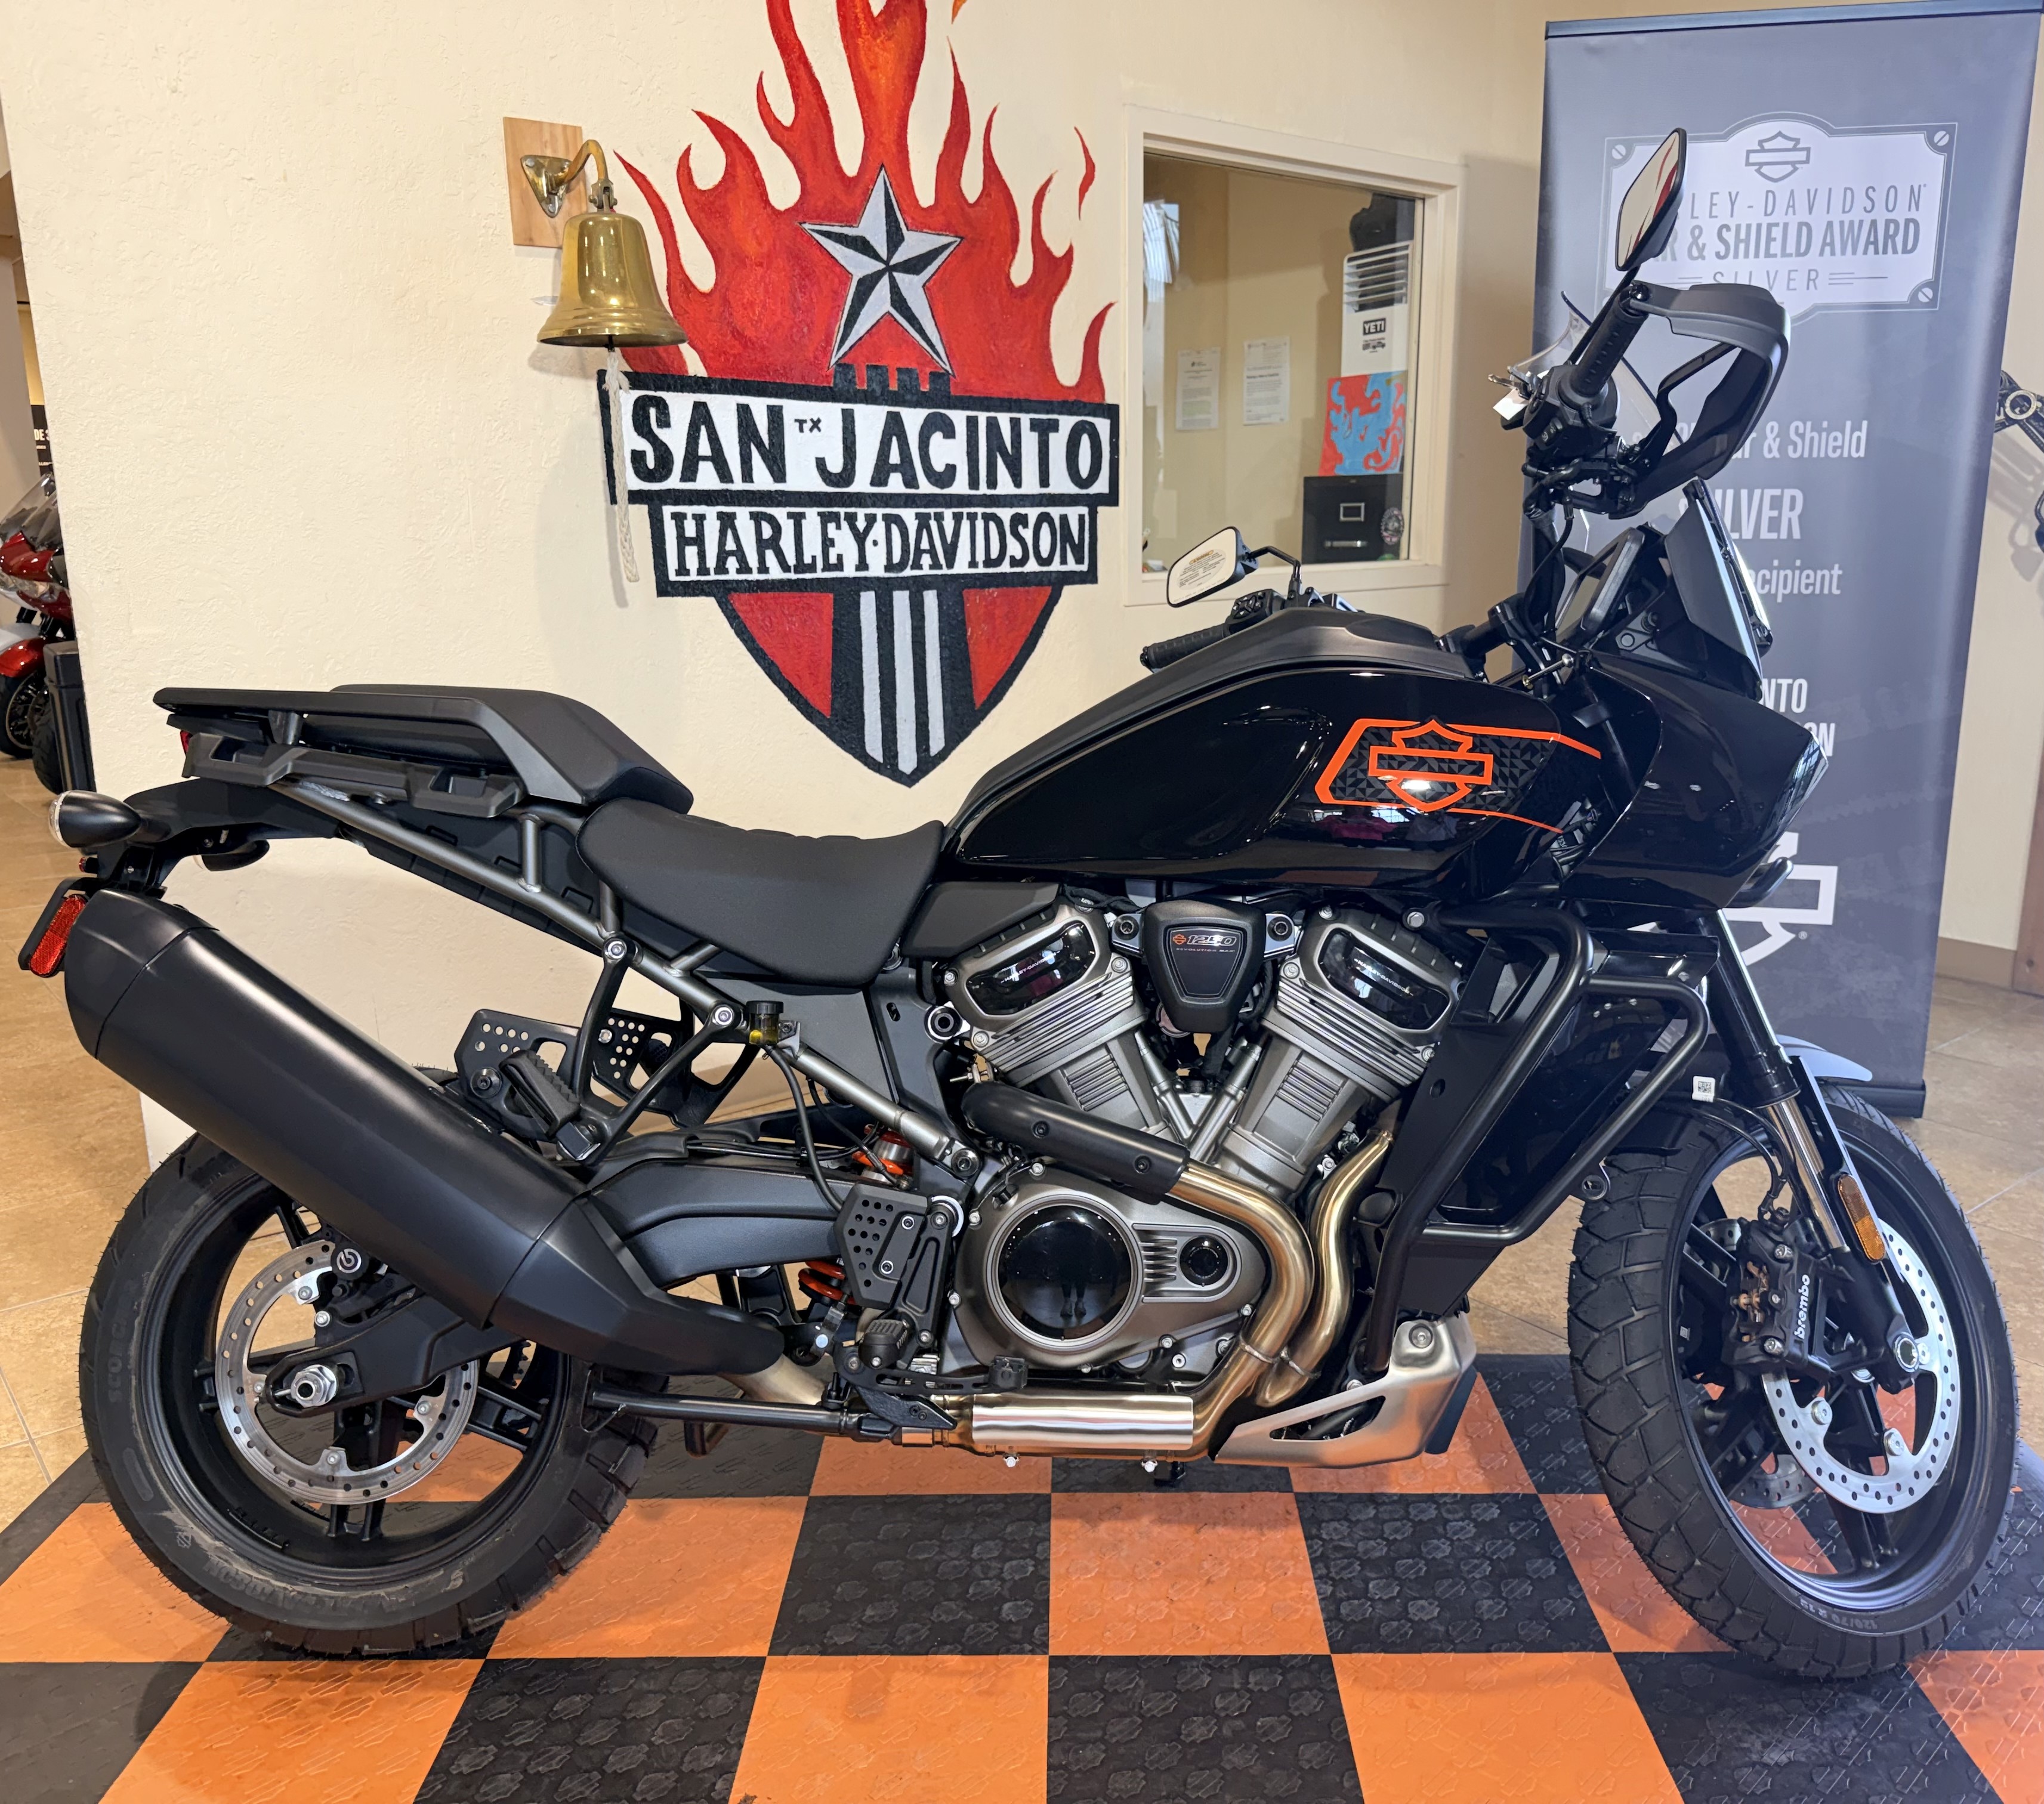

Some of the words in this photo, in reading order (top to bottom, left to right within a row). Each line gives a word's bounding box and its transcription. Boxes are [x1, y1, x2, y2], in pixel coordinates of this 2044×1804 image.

[1677, 185, 1926, 220] LEY-DAVIDSON
[1687, 224, 1706, 261] &
[1715, 221, 1813, 260] SHIELD
[1819, 218, 1921, 257] AWARD
[1364, 320, 1385, 333] YETI
[630, 394, 786, 484] SAN
[794, 416, 822, 433] TX
[816, 407, 1103, 490] JACINTO
[1764, 421, 1780, 459] &
[1787, 420, 1868, 459] Shield
[1713, 489, 1804, 539] ILVER
[1760, 678, 1808, 713] NTO
[1004, 952, 1057, 982] HALEY-DAVIDN
[1794, 1274, 1810, 1340] brembo
